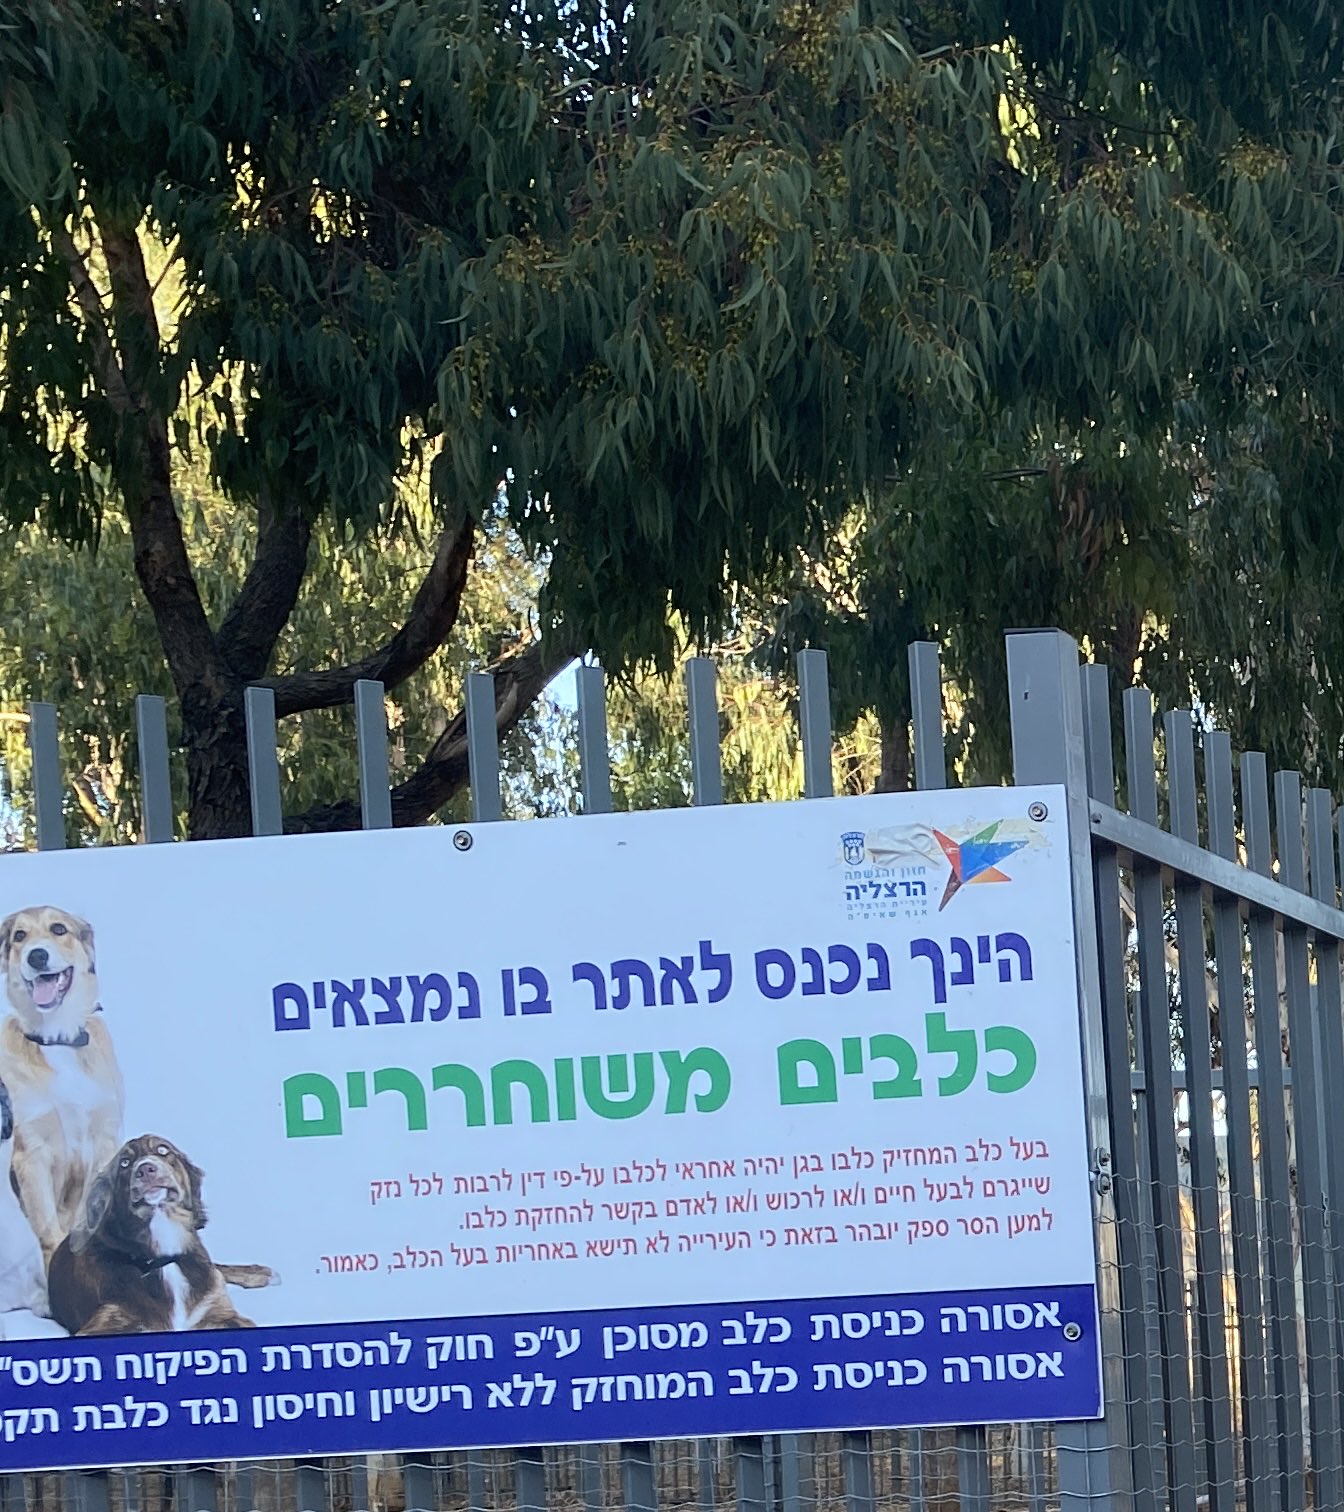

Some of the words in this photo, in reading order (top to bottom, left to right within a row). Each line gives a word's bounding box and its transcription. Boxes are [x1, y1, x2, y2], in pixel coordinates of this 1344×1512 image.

[901, 866, 926, 878] חזון
[846, 881, 926, 900] הרצליה
[572, 940, 732, 1010] לאתר
[754, 943, 891, 999] נכנס
[910, 932, 1033, 1000] הינך
[272, 972, 481, 1031] נמצאים
[501, 967, 552, 1016] בו
[777, 1012, 1036, 1105] כלבים
[284, 1048, 730, 1138] משוחררים
[831, 1145, 875, 1172] כלבו
[882, 1145, 958, 1175] המחזיק
[964, 1137, 1003, 1163] כלב
[1008, 1135, 1050, 1162] בעל
[553, 1162, 605, 1188] על-פי
[612, 1157, 668, 1185] לכלבו
[674, 1159, 737, 1181] אחראי
[743, 1156, 785, 1177] יהיה
[792, 1154, 825, 1180] בגן
[369, 1180, 402, 1206] נזק
[408, 1171, 444, 1197] לכל
[453, 1167, 513, 1195] לרבות
[520, 1171, 546, 1197] דין
[873, 1184, 916, 1205] חיים
[922, 1174, 975, 1204] לבעל
[982, 1176, 1051, 1199] שייגרם
[665, 1190, 718, 1217] לאדם
[765, 1183, 825, 1212] לרכוש
[458, 1204, 508, 1230] כלבו.
[513, 1198, 594, 1232] להחזקת
[600, 1200, 659, 1226] בקשר
[956, 1216, 1000, 1236] הסר
[1007, 1206, 1053, 1240] למען
[645, 1229, 670, 1255] לא
[677, 1230, 752, 1253] העירייה
[759, 1229, 777, 1248] כי
[783, 1225, 839, 1247] בזאת
[843, 1221, 899, 1243] יובהר
[906, 1218, 950, 1246] ספק
[387, 1244, 444, 1275] הכלב,
[449, 1242, 489, 1268] בעל
[494, 1241, 579, 1264] באחריות
[585, 1237, 638, 1259] תישא
[315, 1253, 379, 1275] כאמור.
[722, 1312, 791, 1345] כלב
[811, 1310, 924, 1340] כניסת
[941, 1302, 1062, 1332] אסורה
[262, 1332, 411, 1371] להסדרת
[426, 1335, 493, 1369] חוק
[603, 1322, 708, 1359] מסוכן
[116, 1349, 246, 1384] הפיקוח
[728, 1363, 798, 1394] כלב
[813, 1360, 927, 1390] כניסת
[943, 1352, 1064, 1382] אסורה
[370, 1385, 472, 1421] רישיון
[486, 1374, 556, 1408] ללא
[571, 1371, 713, 1410] המוחזק
[73, 1396, 168, 1431] כלבת
[180, 1398, 238, 1424] נגד
[253, 1391, 355, 1428] וחיסון
[0, 1408, 59, 1441] תק
